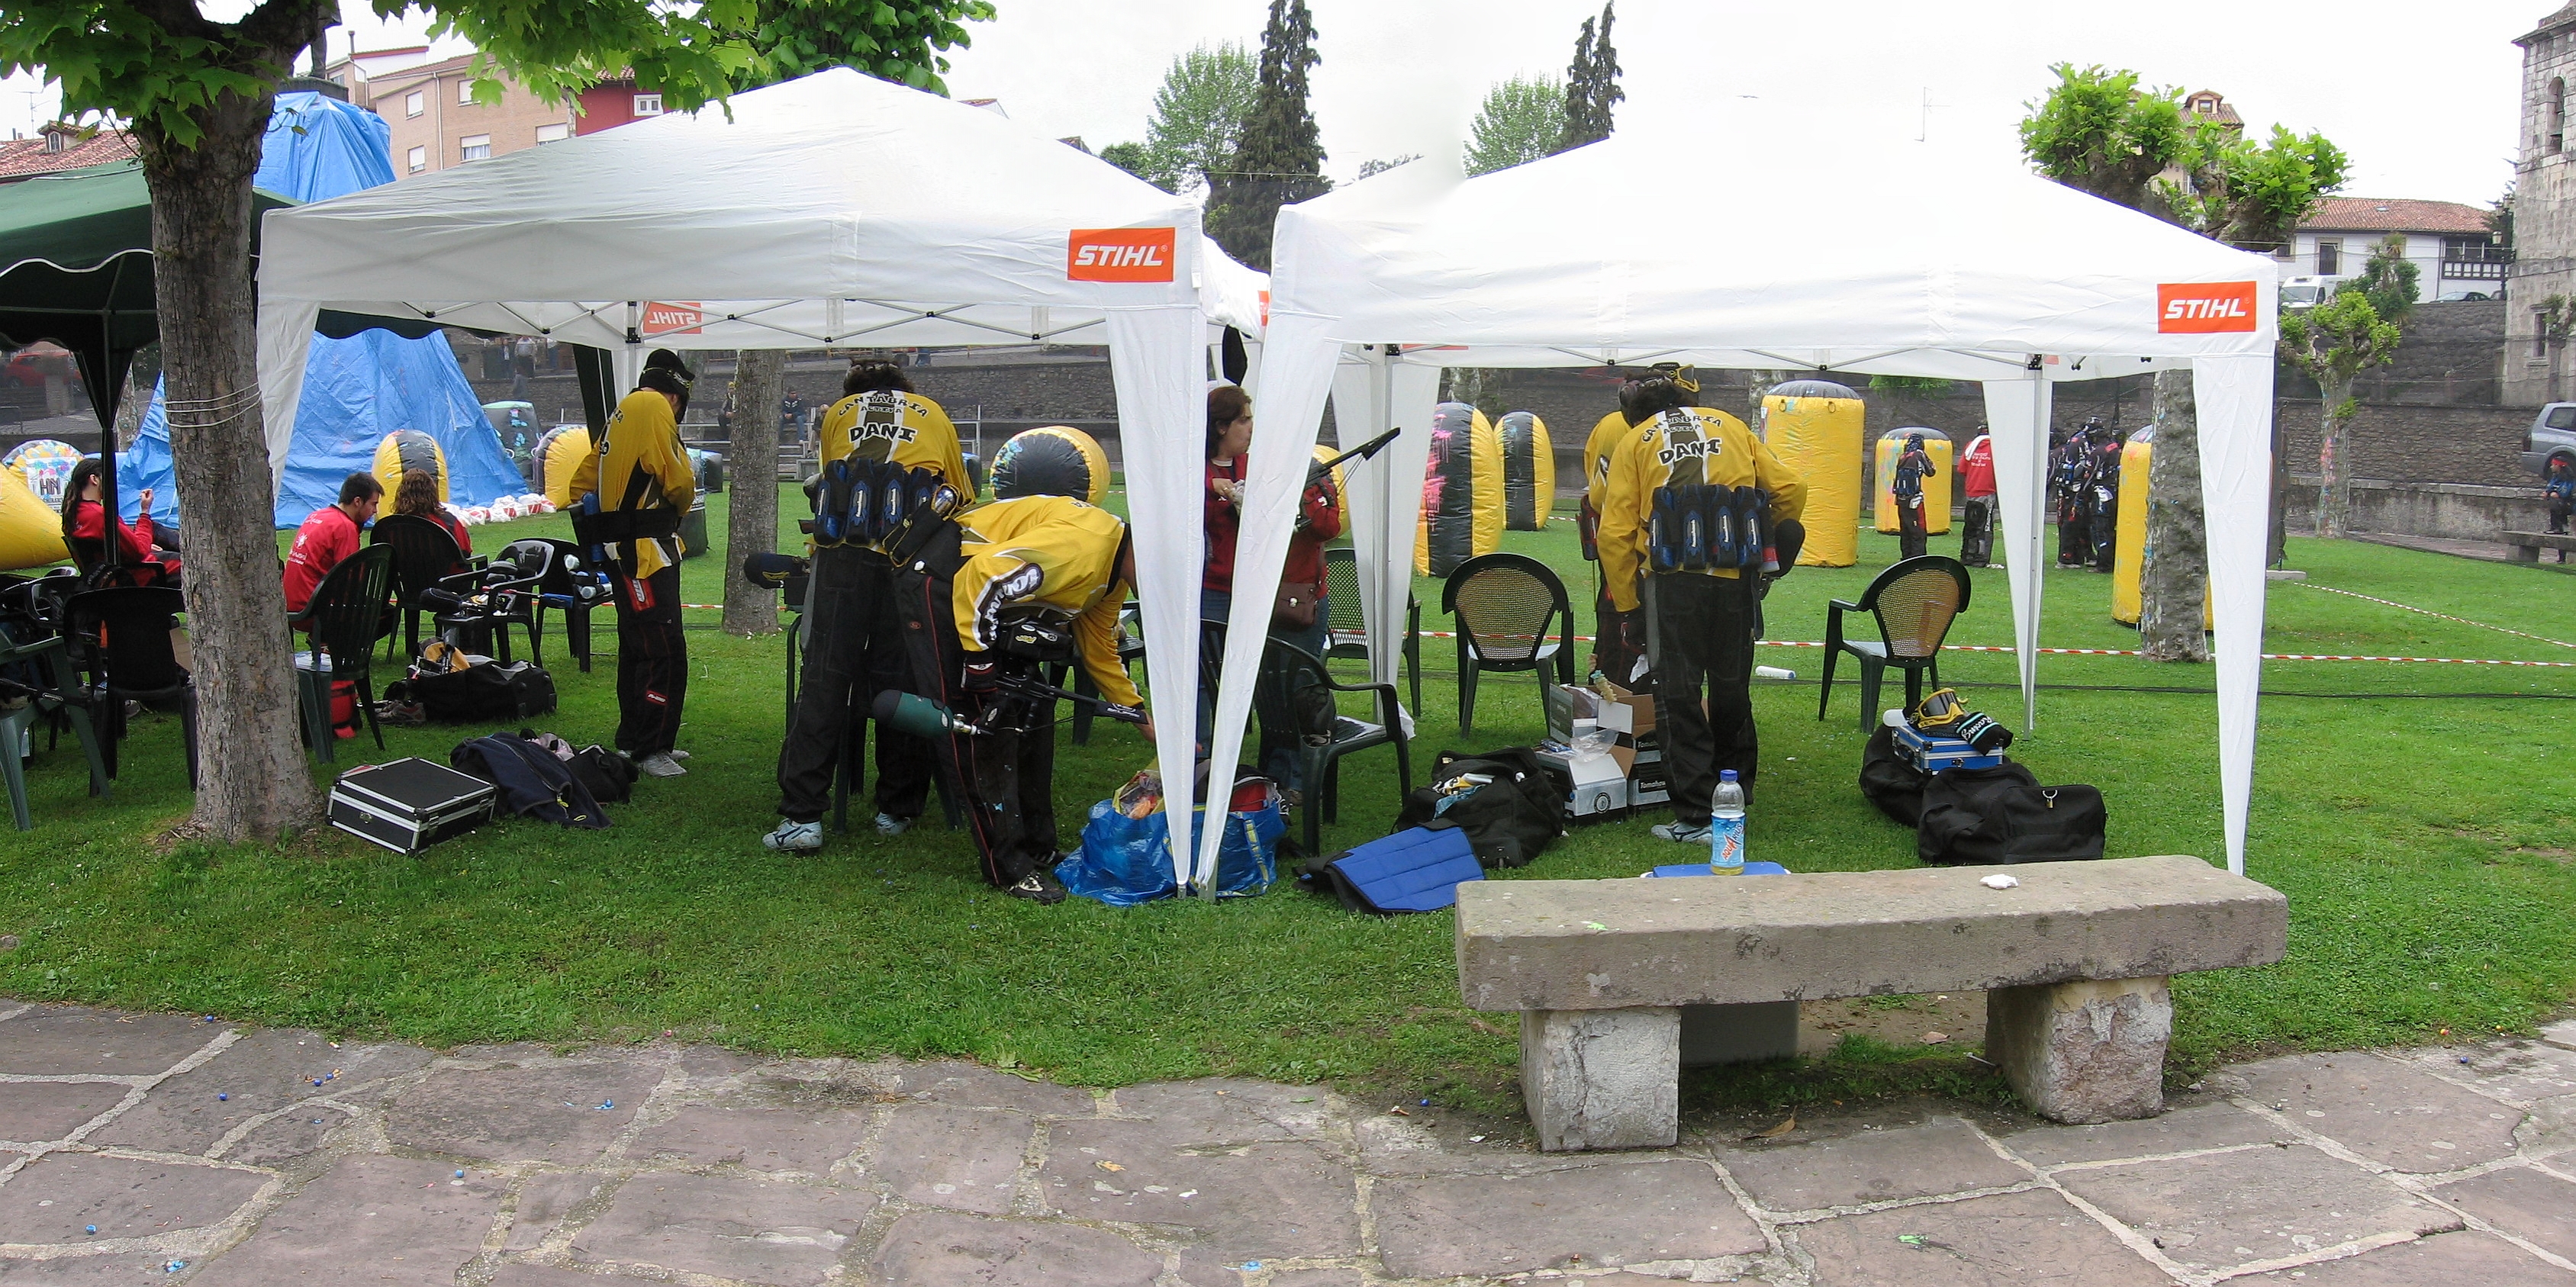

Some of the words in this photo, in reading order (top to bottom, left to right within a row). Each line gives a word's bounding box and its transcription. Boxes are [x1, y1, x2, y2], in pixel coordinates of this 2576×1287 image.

[1074, 245, 1162, 267] STIHL
[2164, 298, 2246, 319] STIHL
[839, 394, 929, 417] CANTABRIA
[848, 422, 918, 443] DANI
[1641, 415, 1723, 442] CANTABRIA
[1658, 438, 1722, 465] DANI
